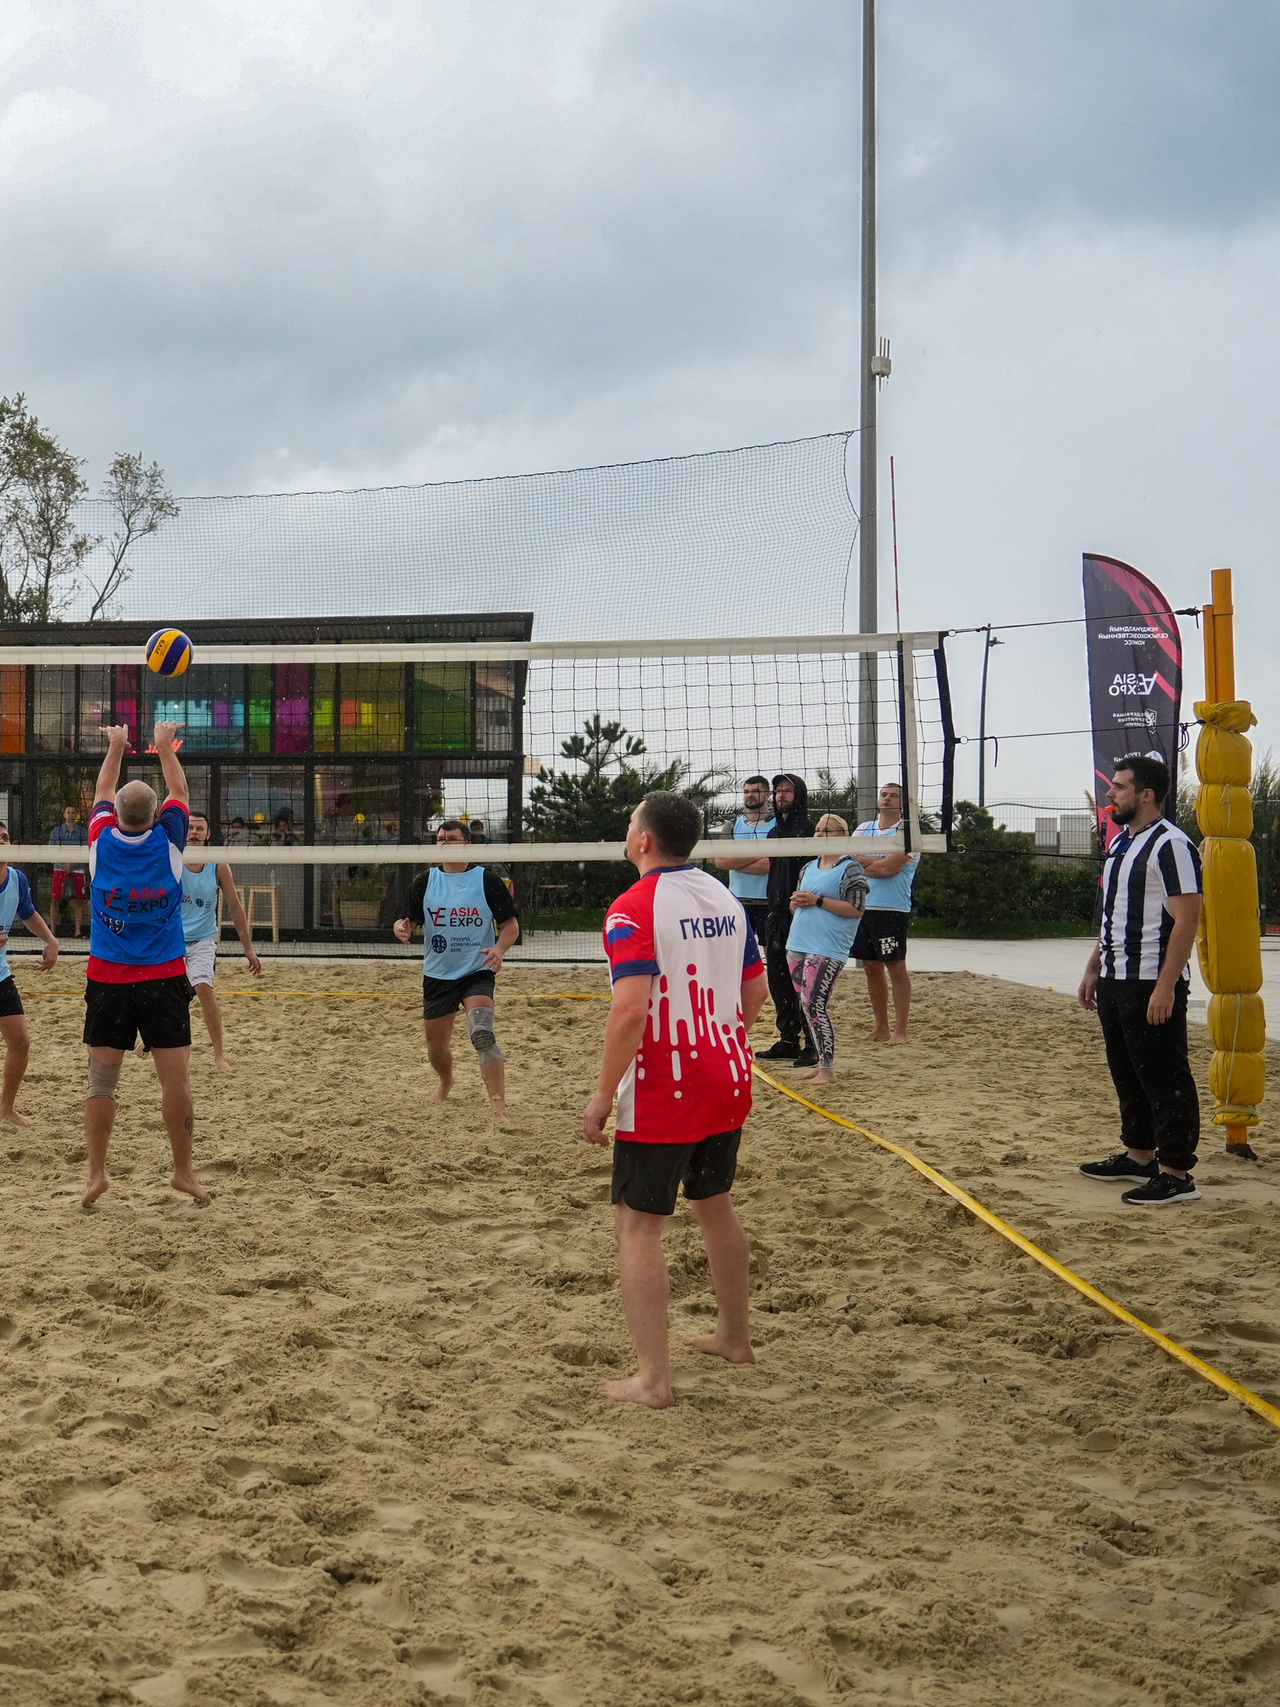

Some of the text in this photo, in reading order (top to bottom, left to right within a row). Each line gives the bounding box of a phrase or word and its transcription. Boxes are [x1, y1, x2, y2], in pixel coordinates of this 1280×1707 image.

[129, 886, 167, 900] ASIA
[128, 896, 169, 913] EXPO
[450, 907, 479, 917] ASIA
[449, 917, 483, 927] EXPO
